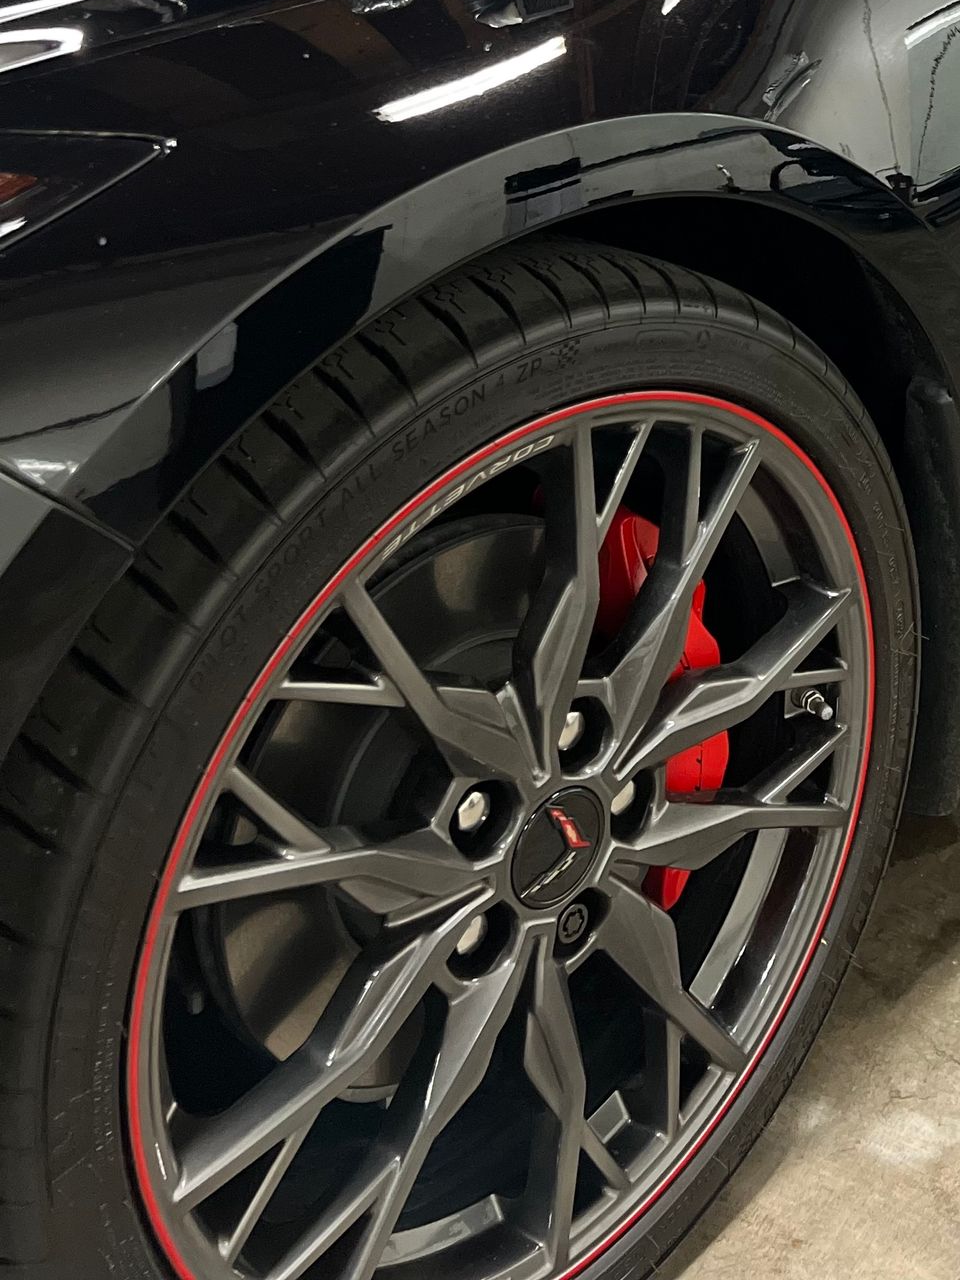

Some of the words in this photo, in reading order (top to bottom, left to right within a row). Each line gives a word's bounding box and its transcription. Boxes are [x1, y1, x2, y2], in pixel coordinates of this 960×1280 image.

[391, 383, 486, 462] SEASON
[517, 357, 543, 384] ZP
[381, 434, 556, 561] CORVETTE
